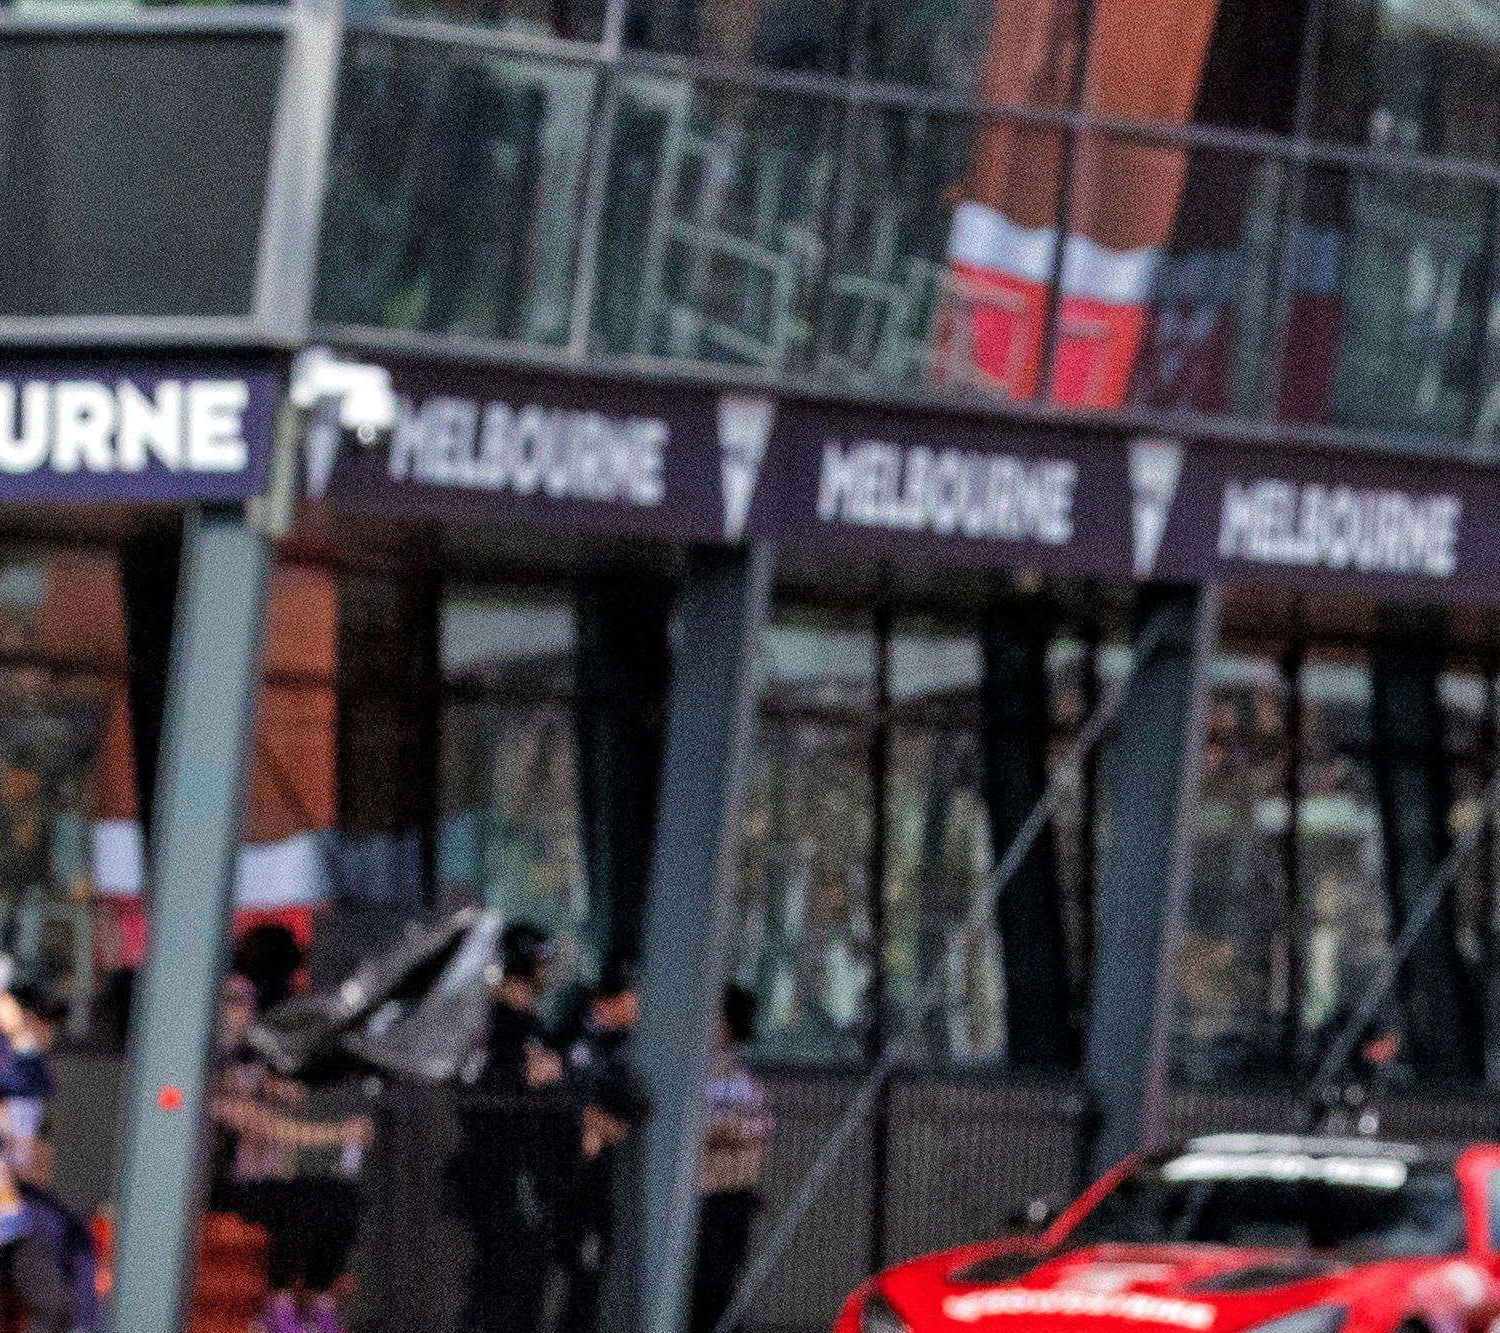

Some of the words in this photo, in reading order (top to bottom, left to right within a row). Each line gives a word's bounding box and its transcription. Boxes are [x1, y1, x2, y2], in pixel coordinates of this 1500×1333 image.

[390, 397, 668, 506] MELBOURNE
[814, 439, 1079, 546] MELBOURNE
[1217, 478, 1460, 577] MELBOURNE
